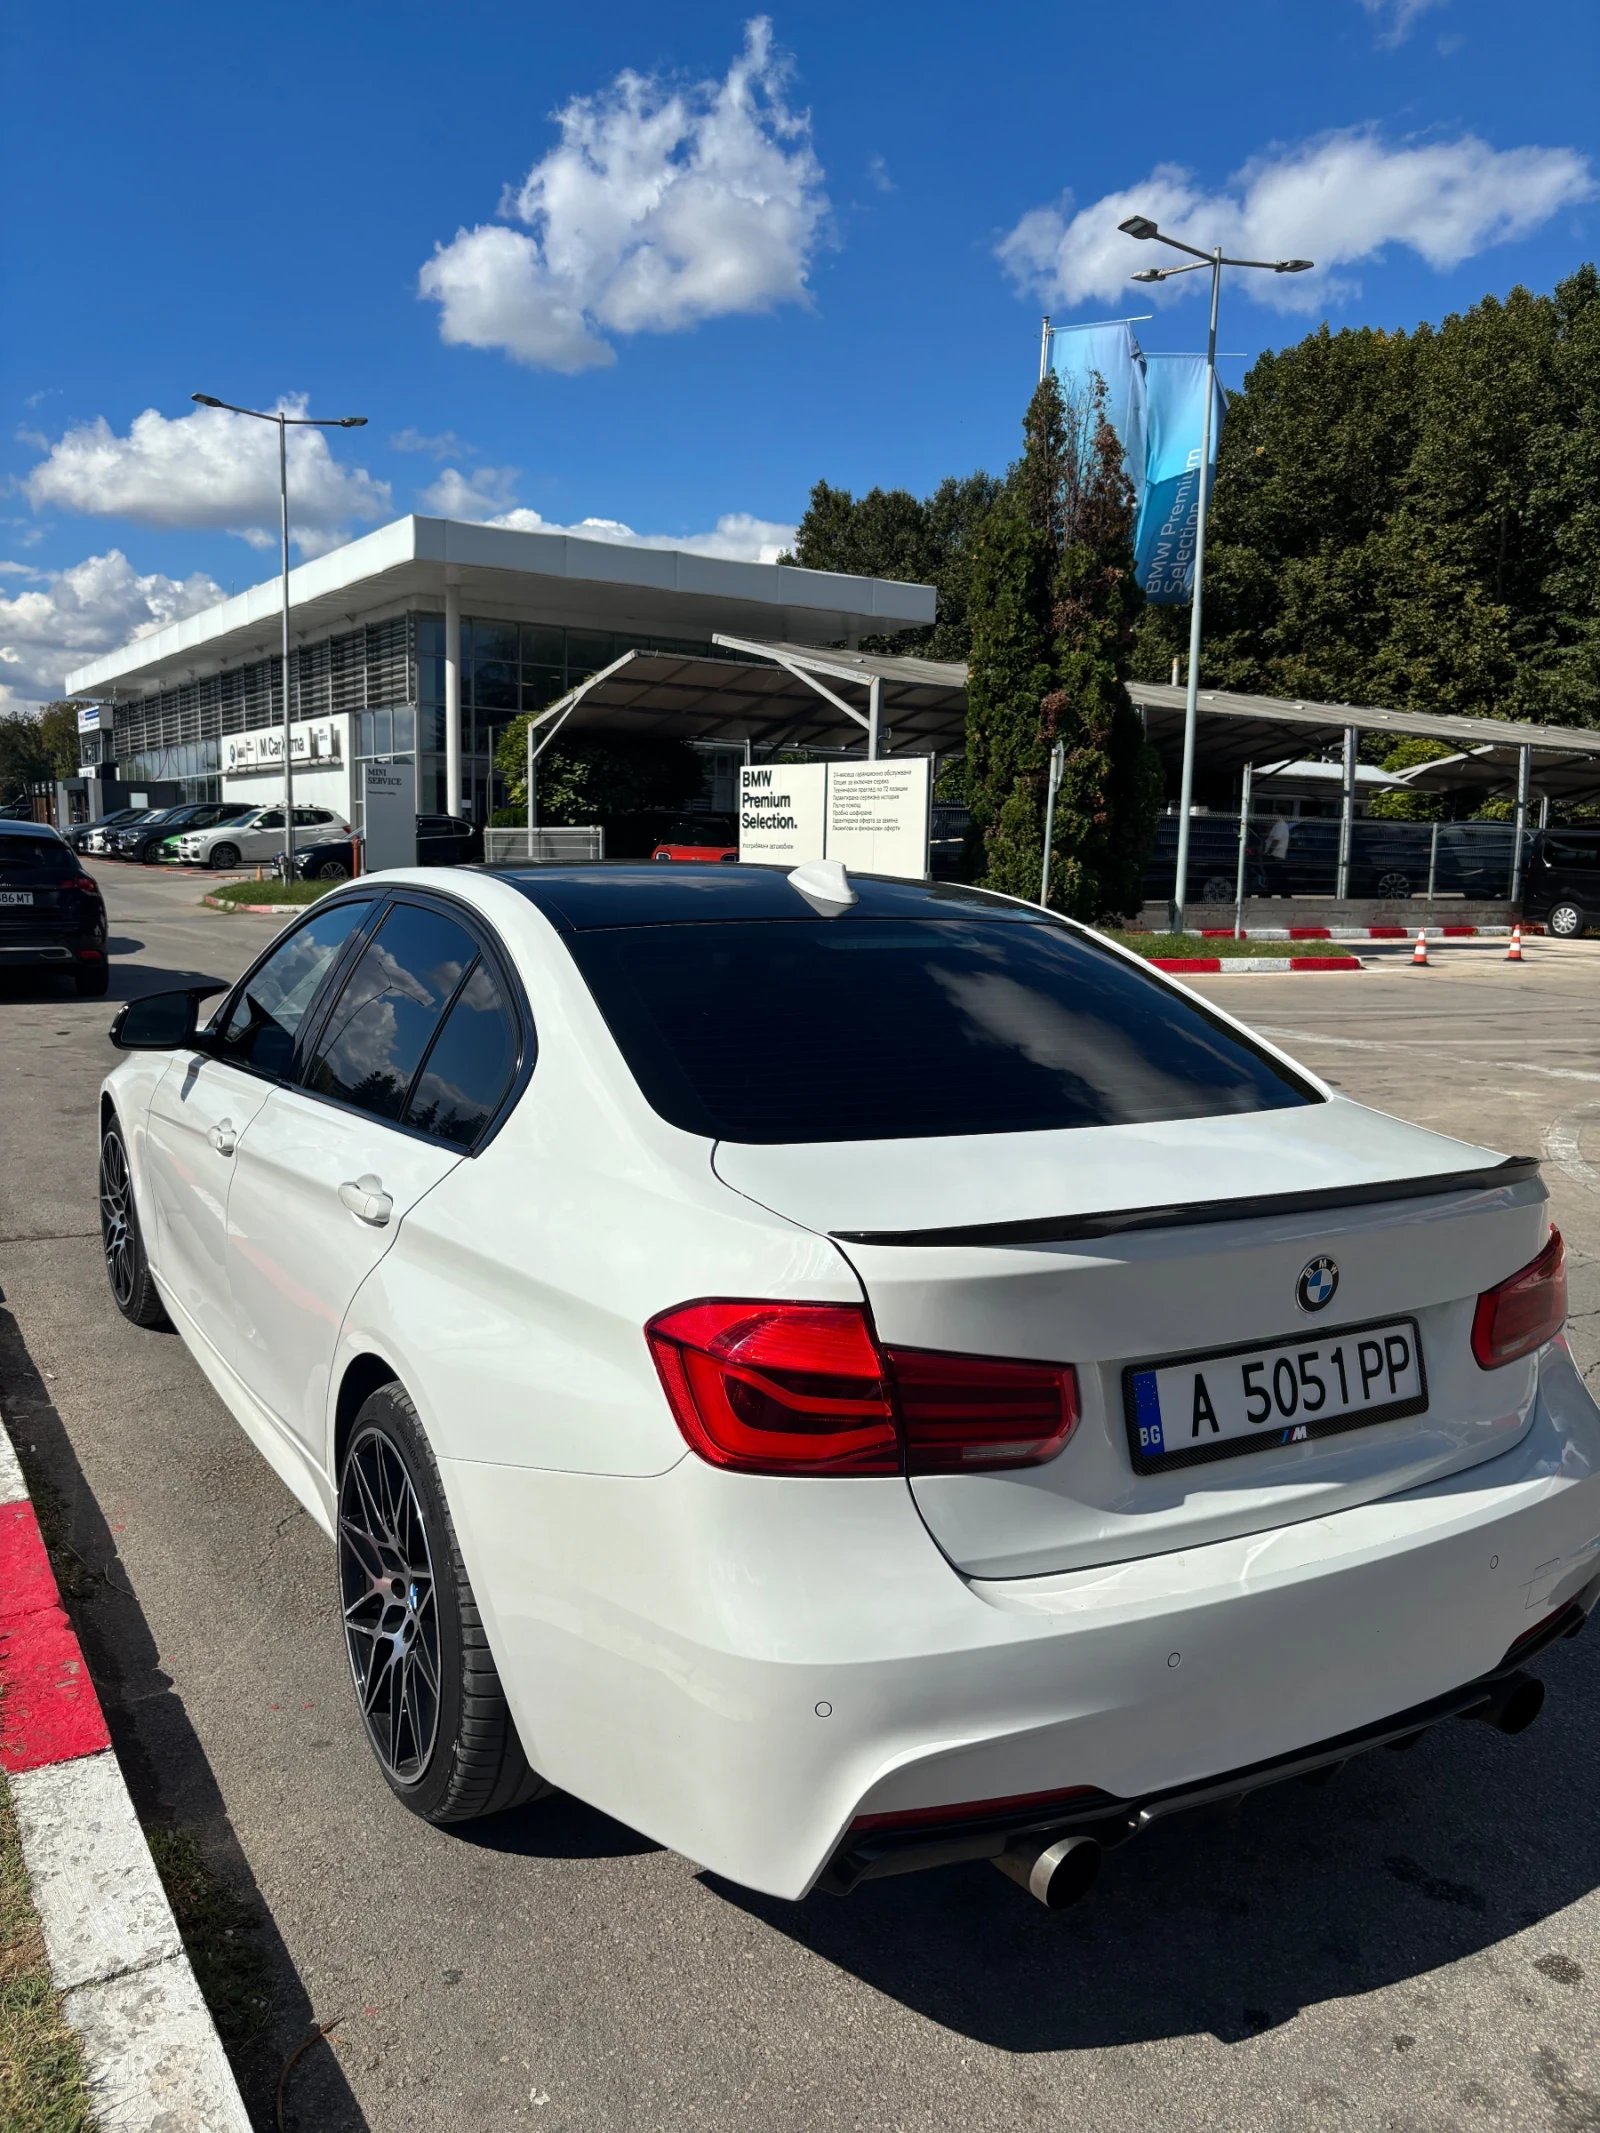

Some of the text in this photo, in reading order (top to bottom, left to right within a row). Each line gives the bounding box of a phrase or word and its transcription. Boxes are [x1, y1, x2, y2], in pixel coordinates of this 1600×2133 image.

[1145, 448, 1202, 594] BMW Premium
[1163, 502, 1200, 594] Selection
[268, 736, 281, 756] Car
[367, 777, 402, 785] SERVICE
[368, 768, 387, 776] MINI
[742, 770, 772, 788] BMW
[742, 791, 791, 808] Premium
[742, 812, 798, 829] Selection.
[0, 893, 32, 904] 86 MT
[1304, 1258, 1340, 1279] BMW
[1191, 1373, 1220, 1438] A
[1139, 1425, 1161, 1447] BG
